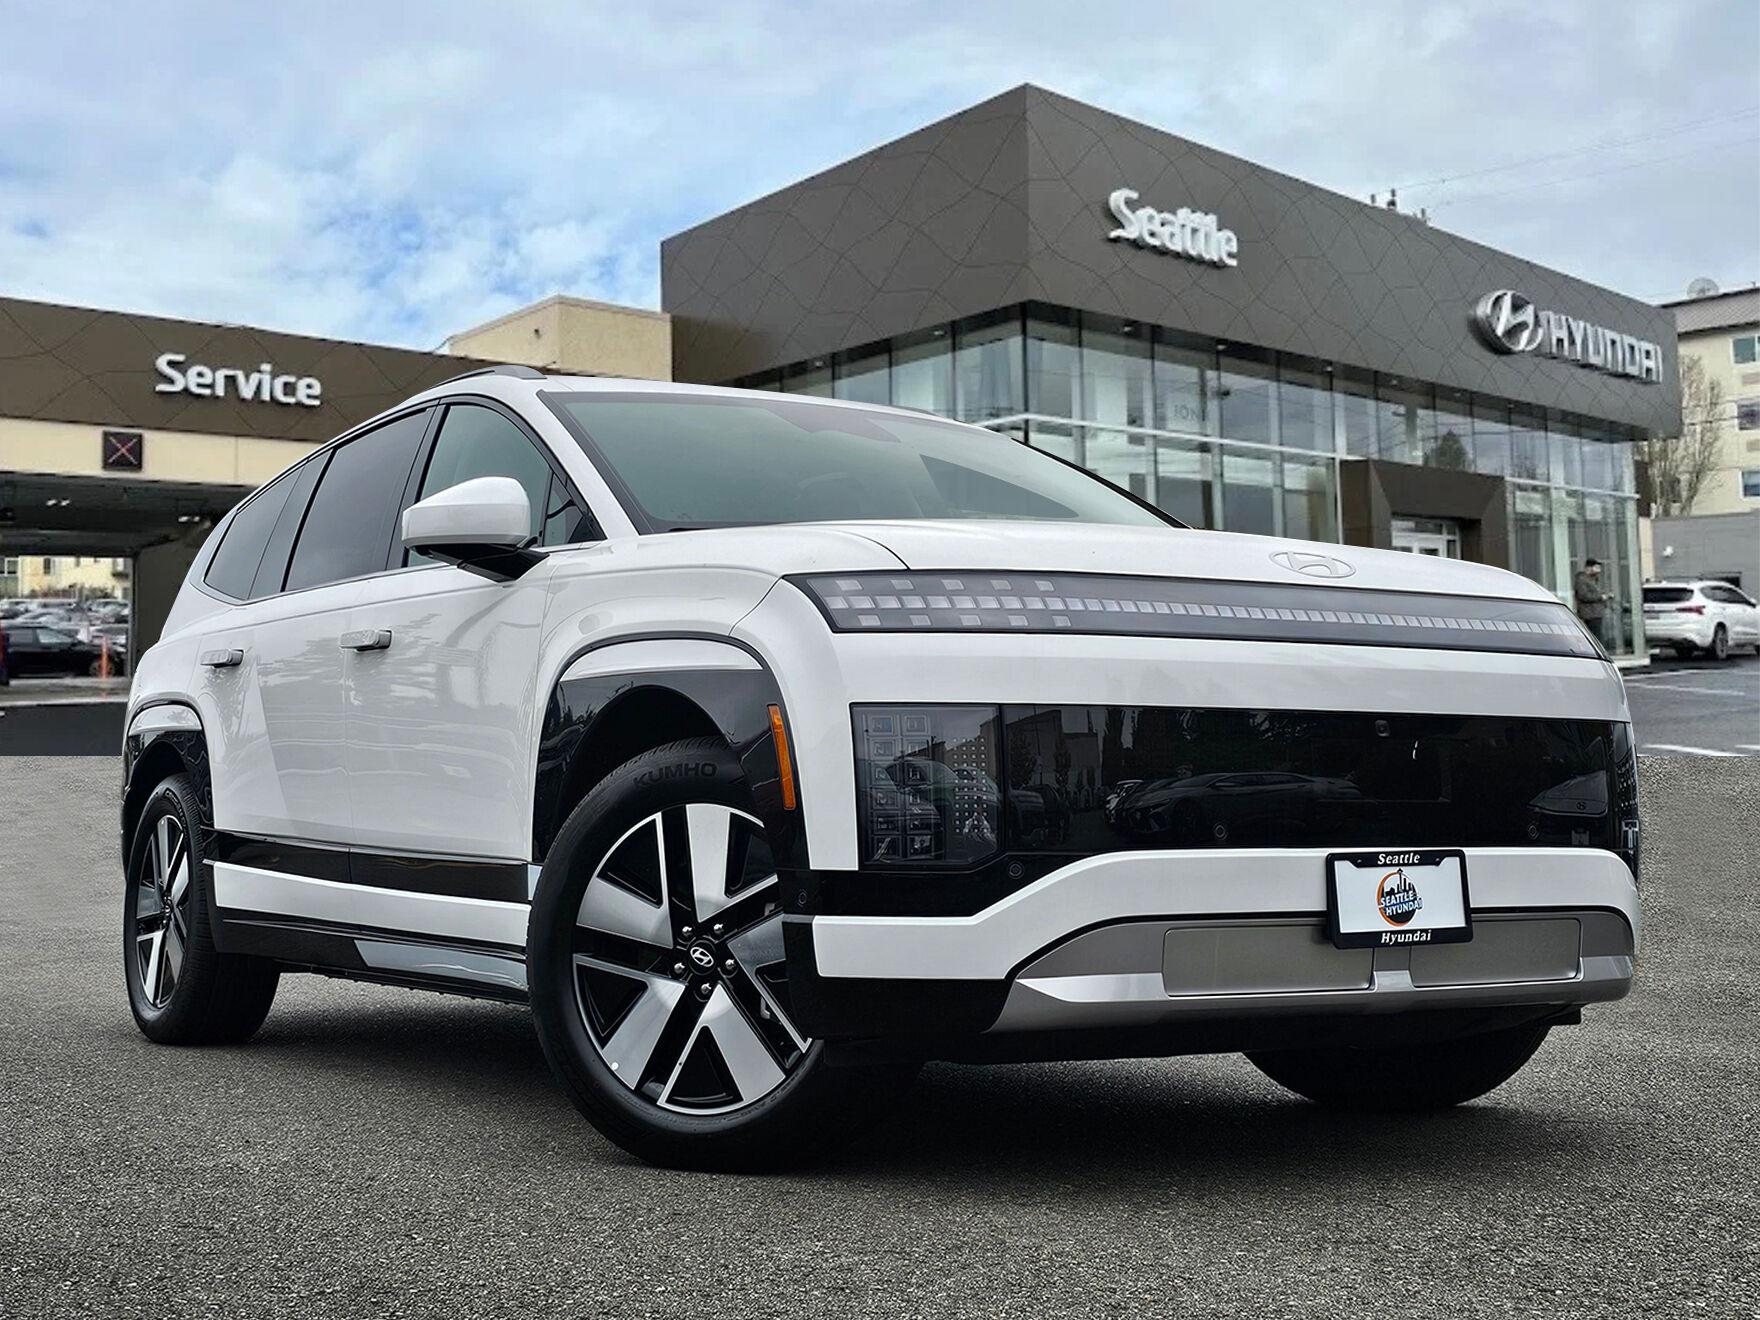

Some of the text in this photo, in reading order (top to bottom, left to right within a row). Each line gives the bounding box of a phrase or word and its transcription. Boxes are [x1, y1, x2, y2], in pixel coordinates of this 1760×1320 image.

[1108, 187, 1238, 267] Seattle
[1542, 311, 1663, 383] HYUNDAI
[155, 352, 322, 406] Service
[633, 762, 718, 786] KUMHO
[1378, 853, 1420, 865] Seattle
[1380, 891, 1414, 907] SEATTLE
[1386, 898, 1424, 917] HYUNDAI
[1381, 930, 1432, 945] Hyundai
